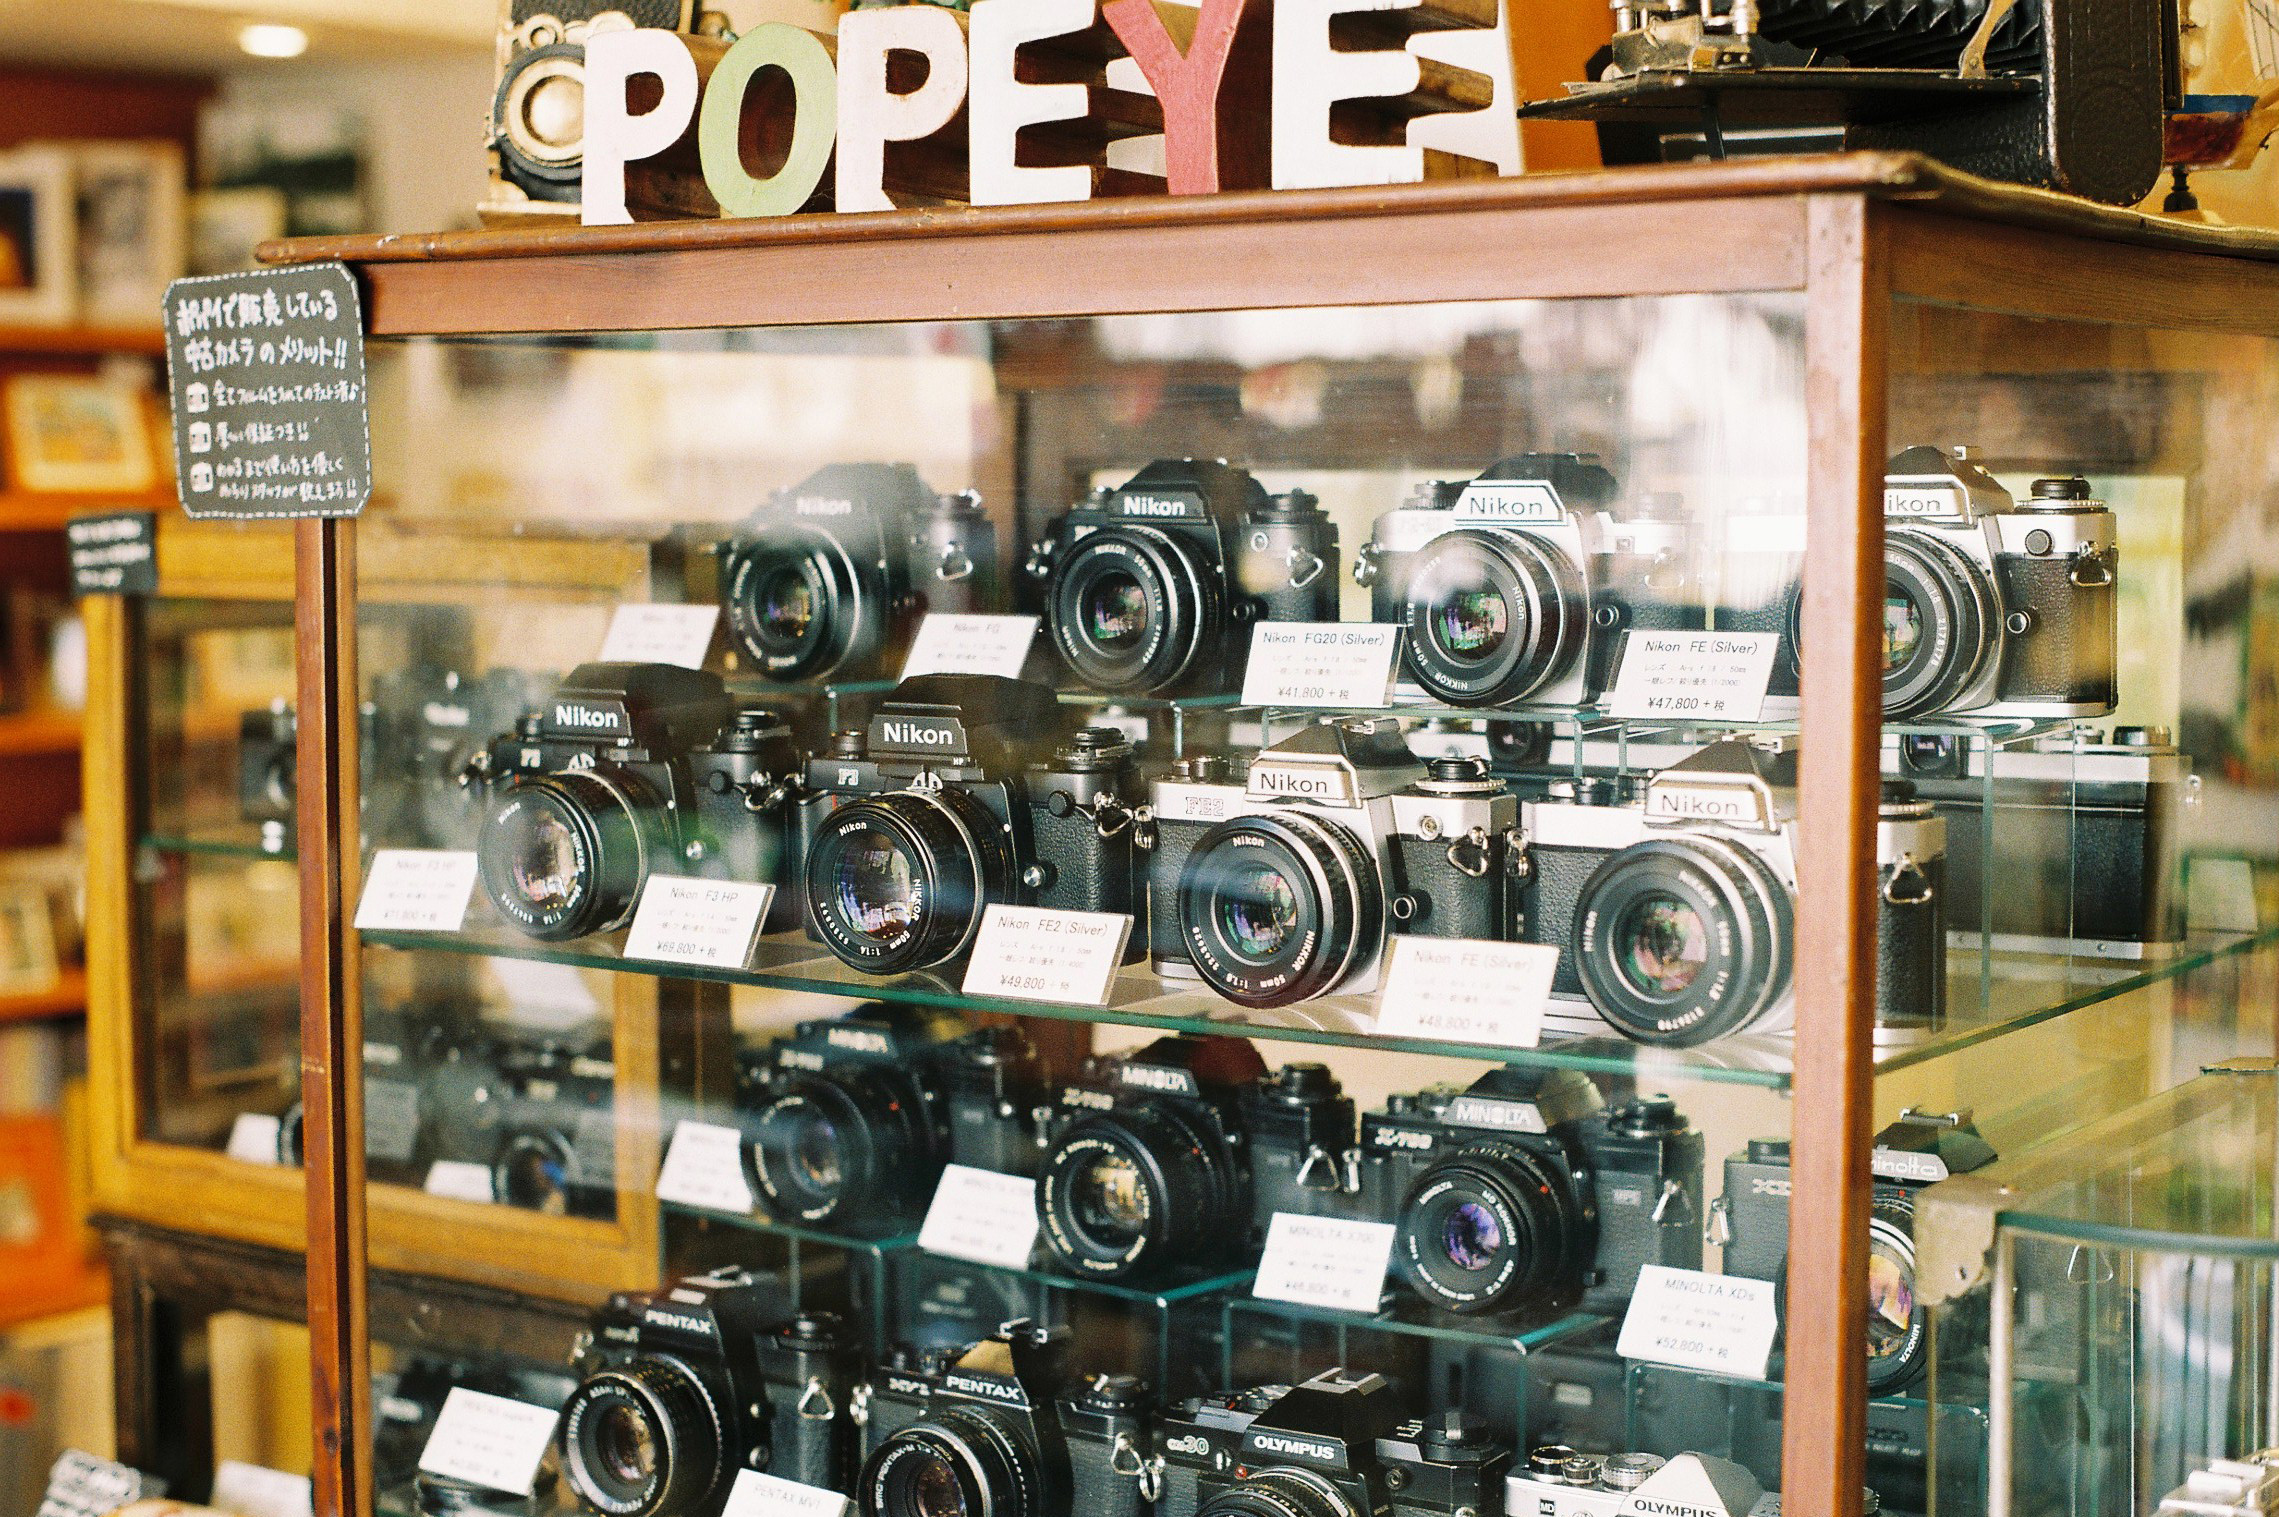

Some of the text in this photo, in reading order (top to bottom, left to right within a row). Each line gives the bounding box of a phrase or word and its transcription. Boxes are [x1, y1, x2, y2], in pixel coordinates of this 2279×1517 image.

[582, 0, 1424, 226] POPEYE
[1123, 496, 1186, 516] Nikon
[1469, 496, 1543, 517] Nikon
[1887, 494, 1941, 513] ikon
[1888, 553, 1915, 573] 50mm
[1511, 585, 1525, 621] Nikon
[1263, 631, 1385, 647] Nikon FG20 (Silver)
[1644, 639, 1758, 656] Nikon FE (Silver)
[1278, 686, 1325, 699] ¥41,800
[1647, 696, 1699, 710] ¥47,800
[555, 703, 619, 729] Nikon
[883, 722, 954, 746] Nikon
[1260, 772, 1329, 795] Nikon
[1184, 795, 1225, 817] FE2
[1660, 793, 1739, 817] Nikon
[838, 821, 868, 837] Nikon
[1232, 835, 1266, 848] Nikon
[670, 886, 739, 903] Nikon F3 HP
[910, 878, 922, 922] NIKKOR
[997, 915, 1108, 938] Nikon FE2 (Silver)
[889, 930, 911, 950] 50mm
[1291, 929, 1316, 972] NIKKOR
[1413, 949, 1452, 964] Nikon
[1460, 952, 1480, 968] FE
[999, 973, 1046, 991] ¥49,800
[1259, 973, 1287, 989] 50mm
[1456, 1102, 1532, 1127] MINOLTA
[1664, 1277, 1724, 1297] MINOLTA
[645, 1308, 712, 1335] PENTAX
[1655, 1335, 1705, 1355] ¥52,800
[1898, 1323, 1921, 1363] MINOLTA
[946, 1376, 1020, 1401] PENTAX
[1253, 1435, 1335, 1460] OLYMPUS
[1540, 1500, 1555, 1515] MD
[1634, 1499, 1717, 1517] OLYMPUS
